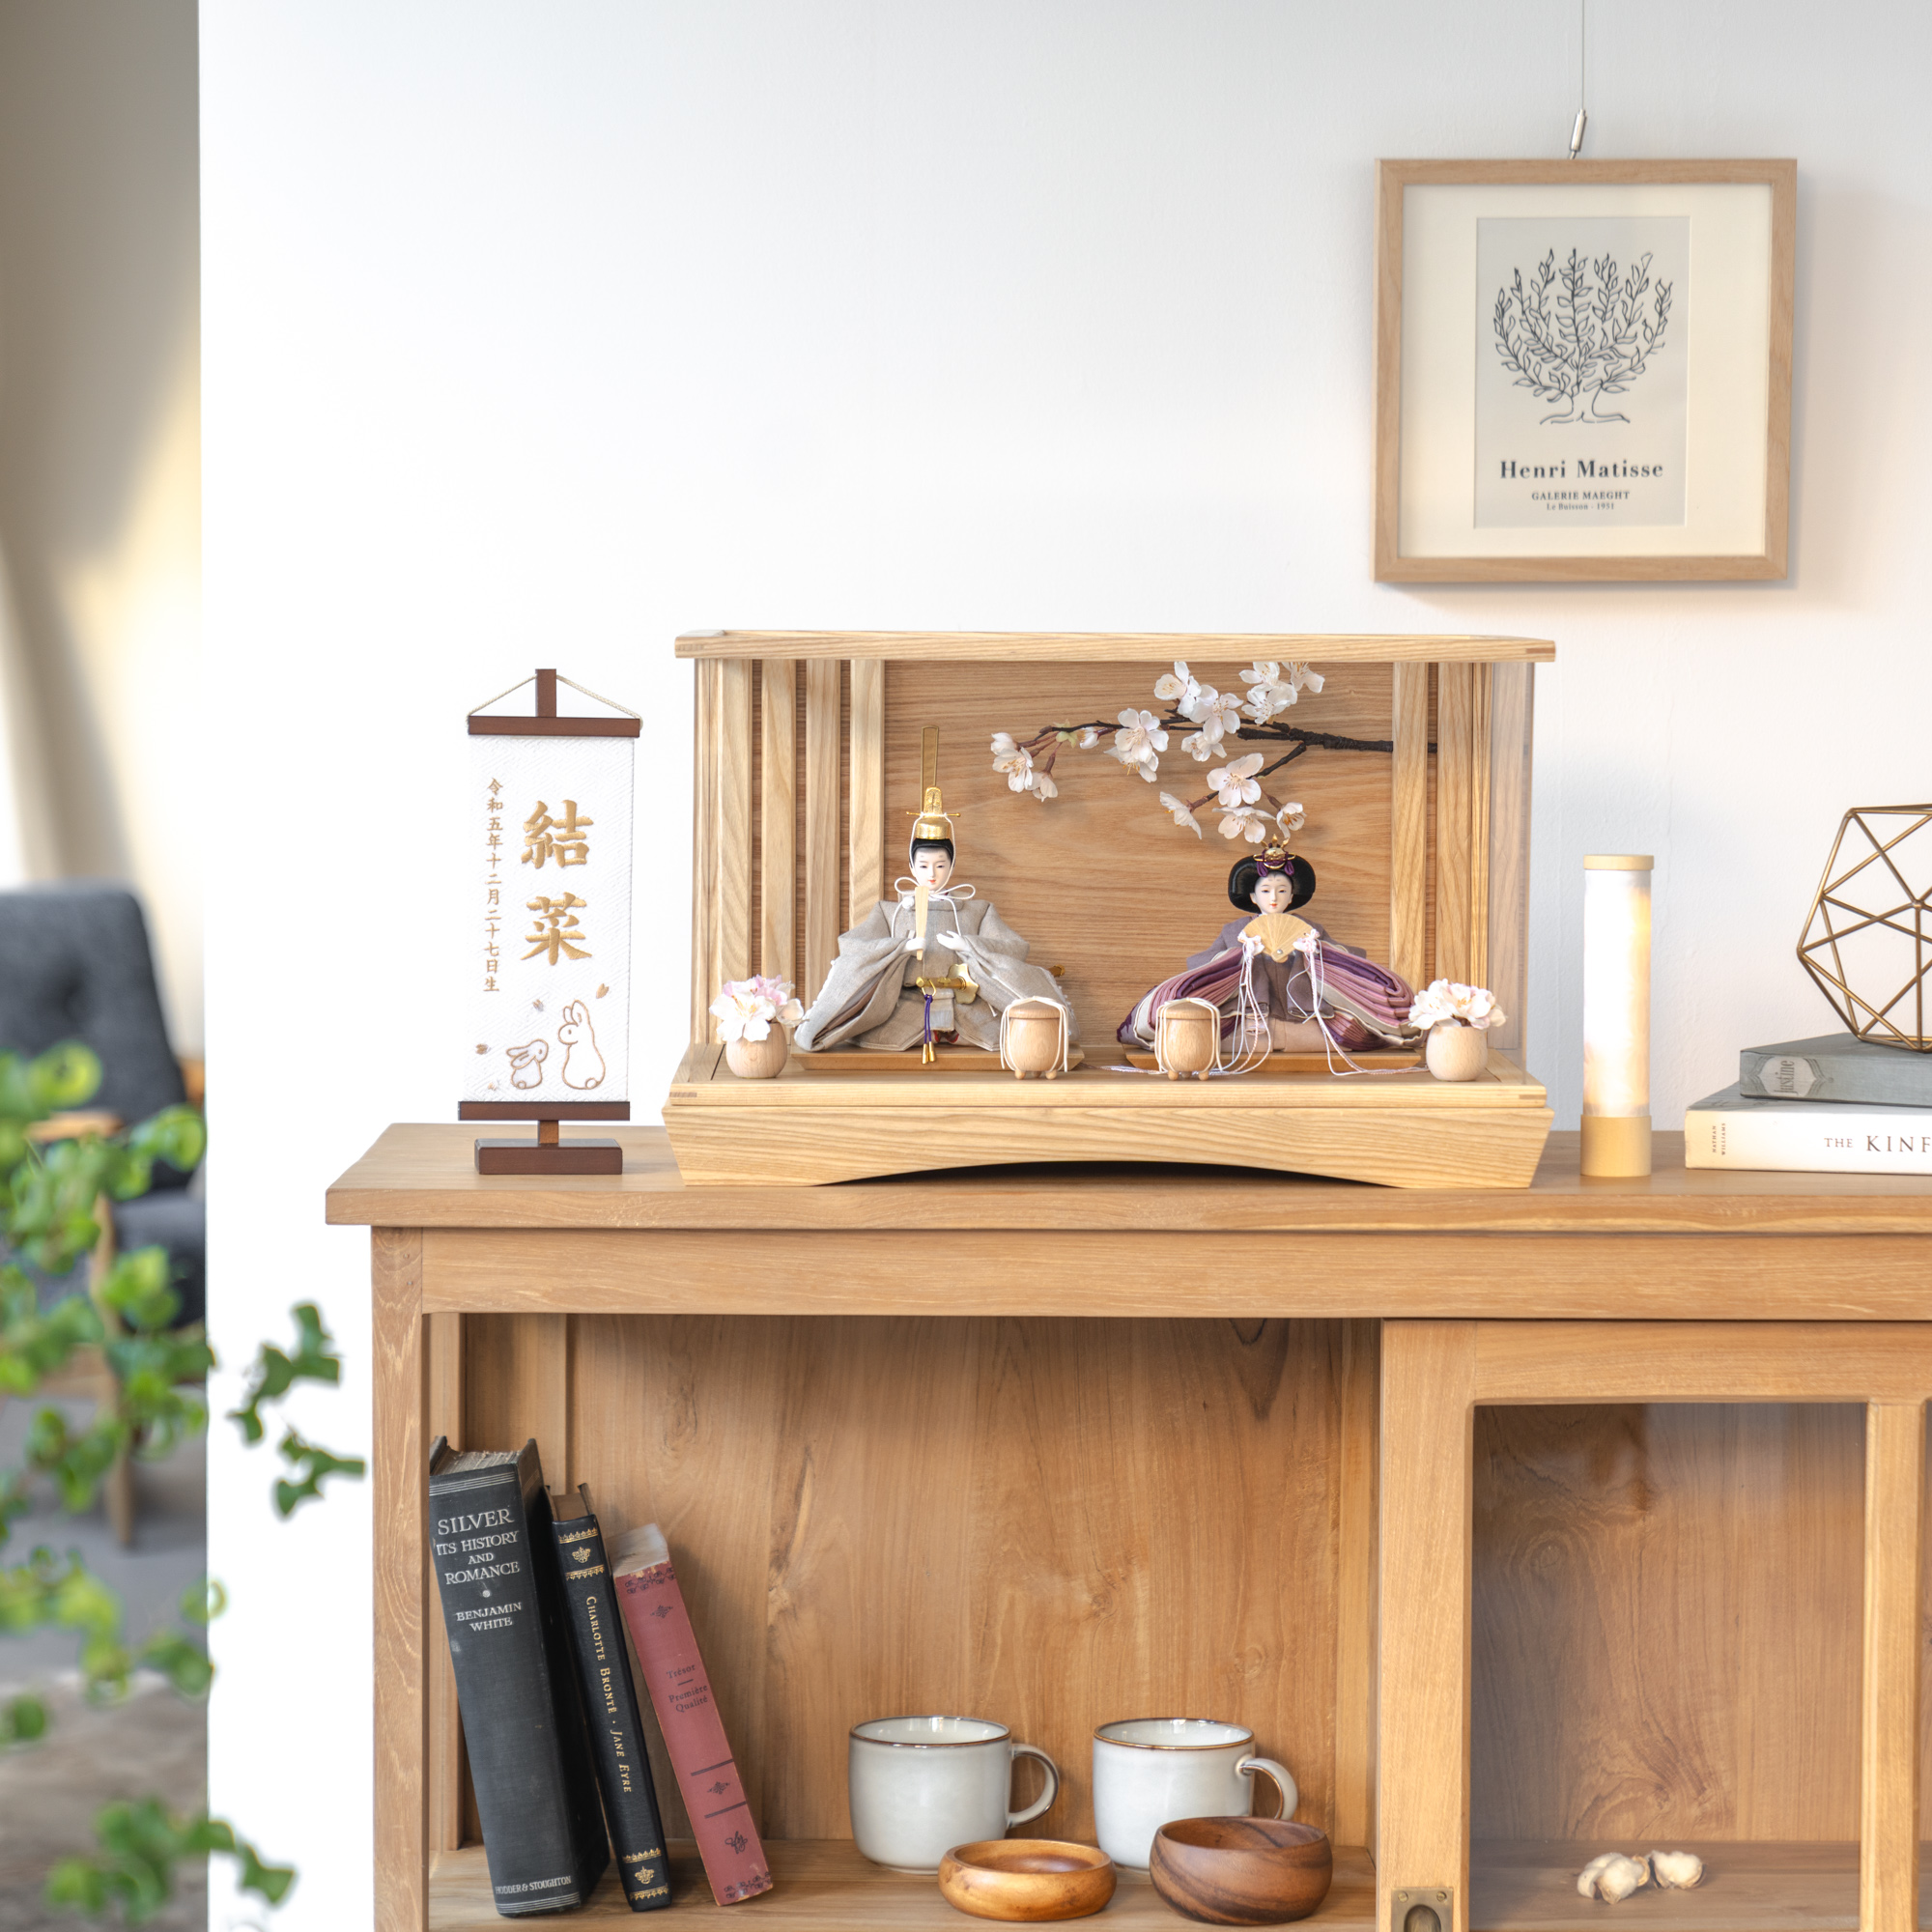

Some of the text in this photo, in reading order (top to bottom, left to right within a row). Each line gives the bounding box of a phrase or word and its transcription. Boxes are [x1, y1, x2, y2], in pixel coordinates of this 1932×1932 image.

[1500, 459, 1663, 479] Henri Matisse
[1531, 491, 1631, 501] GALERIE MAEGHT
[1546, 502, 1615, 511] Le Buisson 1951
[482, 777, 504, 992] 令和五年十二月二十七日生
[520, 799, 594, 966] 結菜
[1823, 1135, 1931, 1153] THE KINF
[438, 1508, 515, 1536] SILVER
[436, 1530, 520, 1556] ITS HISTORY
[468, 1552, 495, 1565] AND
[444, 1561, 521, 1585] ROMANCE
[456, 1602, 523, 1622] BENJAMIN
[469, 1616, 514, 1633] WHITE
[667, 1664, 696, 1679] Trésor
[585, 1596, 606, 1662] CHARLOTTE
[610, 1728, 625, 1757] JANE
[618, 1764, 632, 1793] EYRE
[675, 1694, 708, 1713] Qualité
[495, 1875, 572, 1895] HODDER & STOUGHTON
